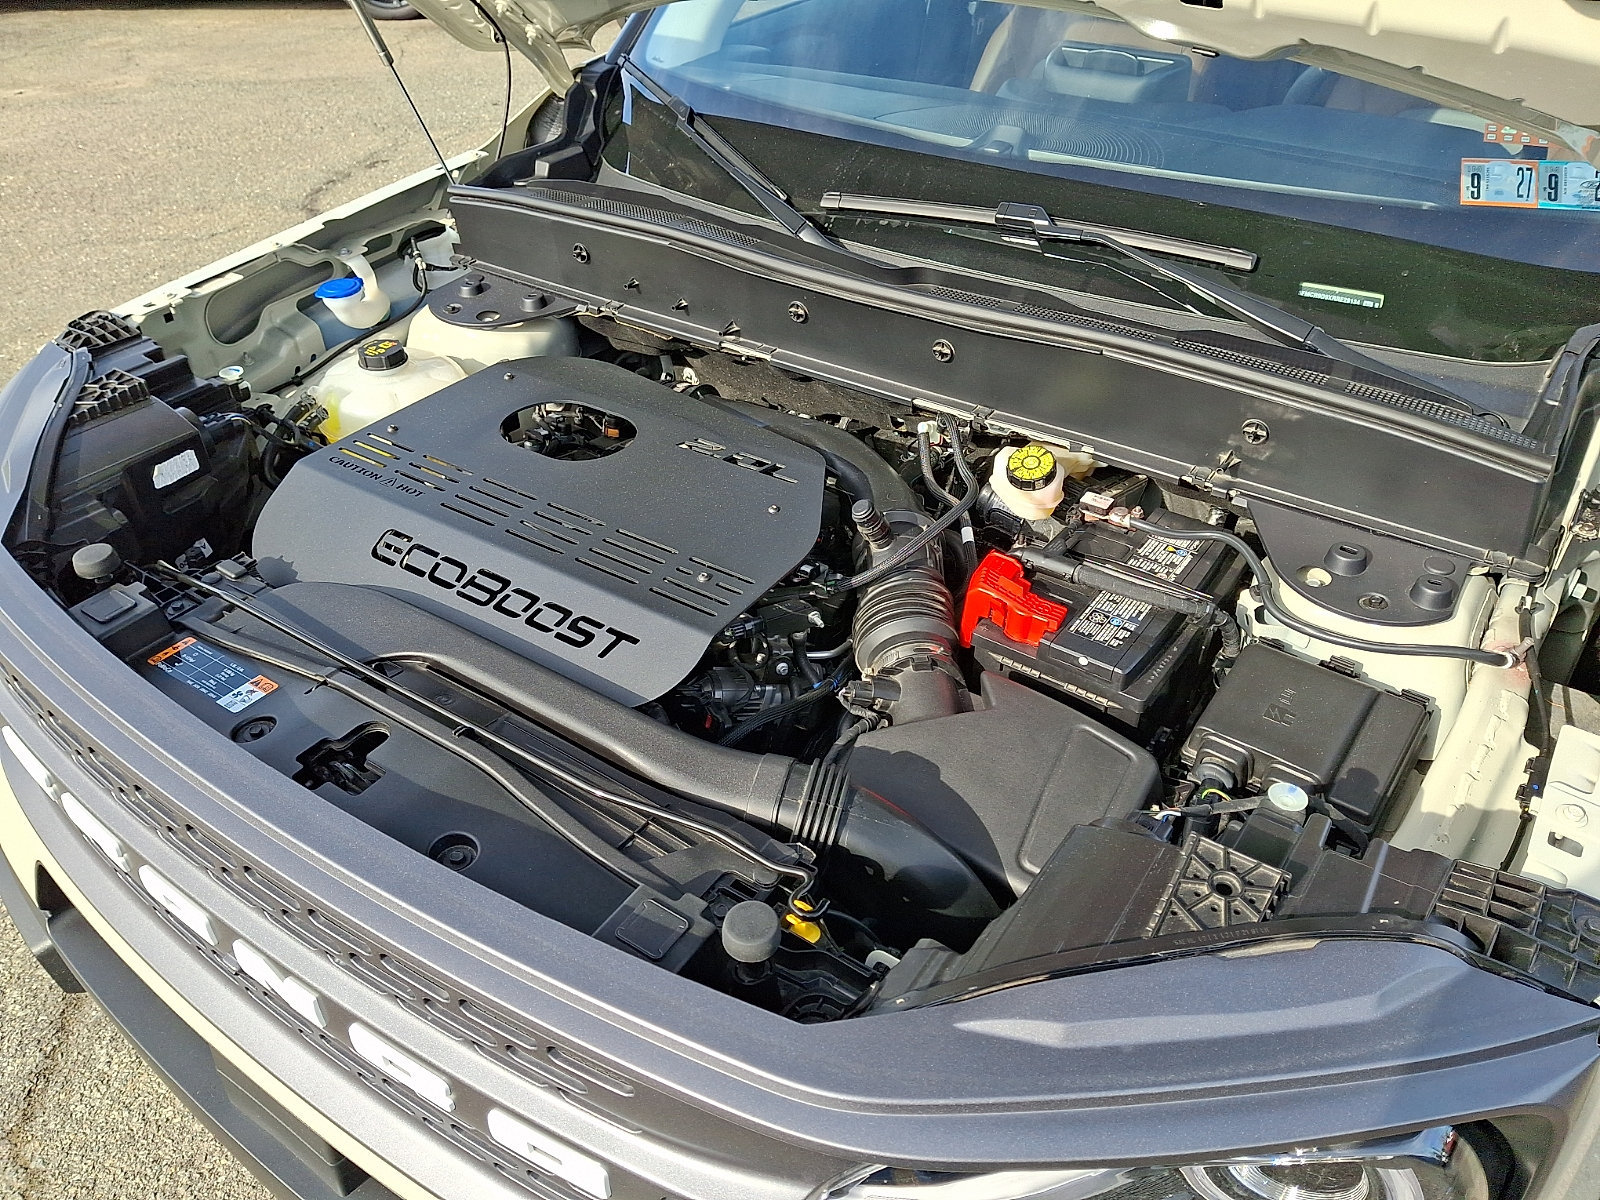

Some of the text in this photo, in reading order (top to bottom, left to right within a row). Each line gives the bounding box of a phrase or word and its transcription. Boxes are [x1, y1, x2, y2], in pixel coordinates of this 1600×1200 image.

[1470, 173, 1482, 200] 9
[1516, 167, 1534, 199] 27
[1548, 173, 1559, 202] 9
[328, 456, 426, 498] CAUTION HOT
[676, 438, 799, 484] 2.0L
[371, 528, 641, 659] ECOBOOST
